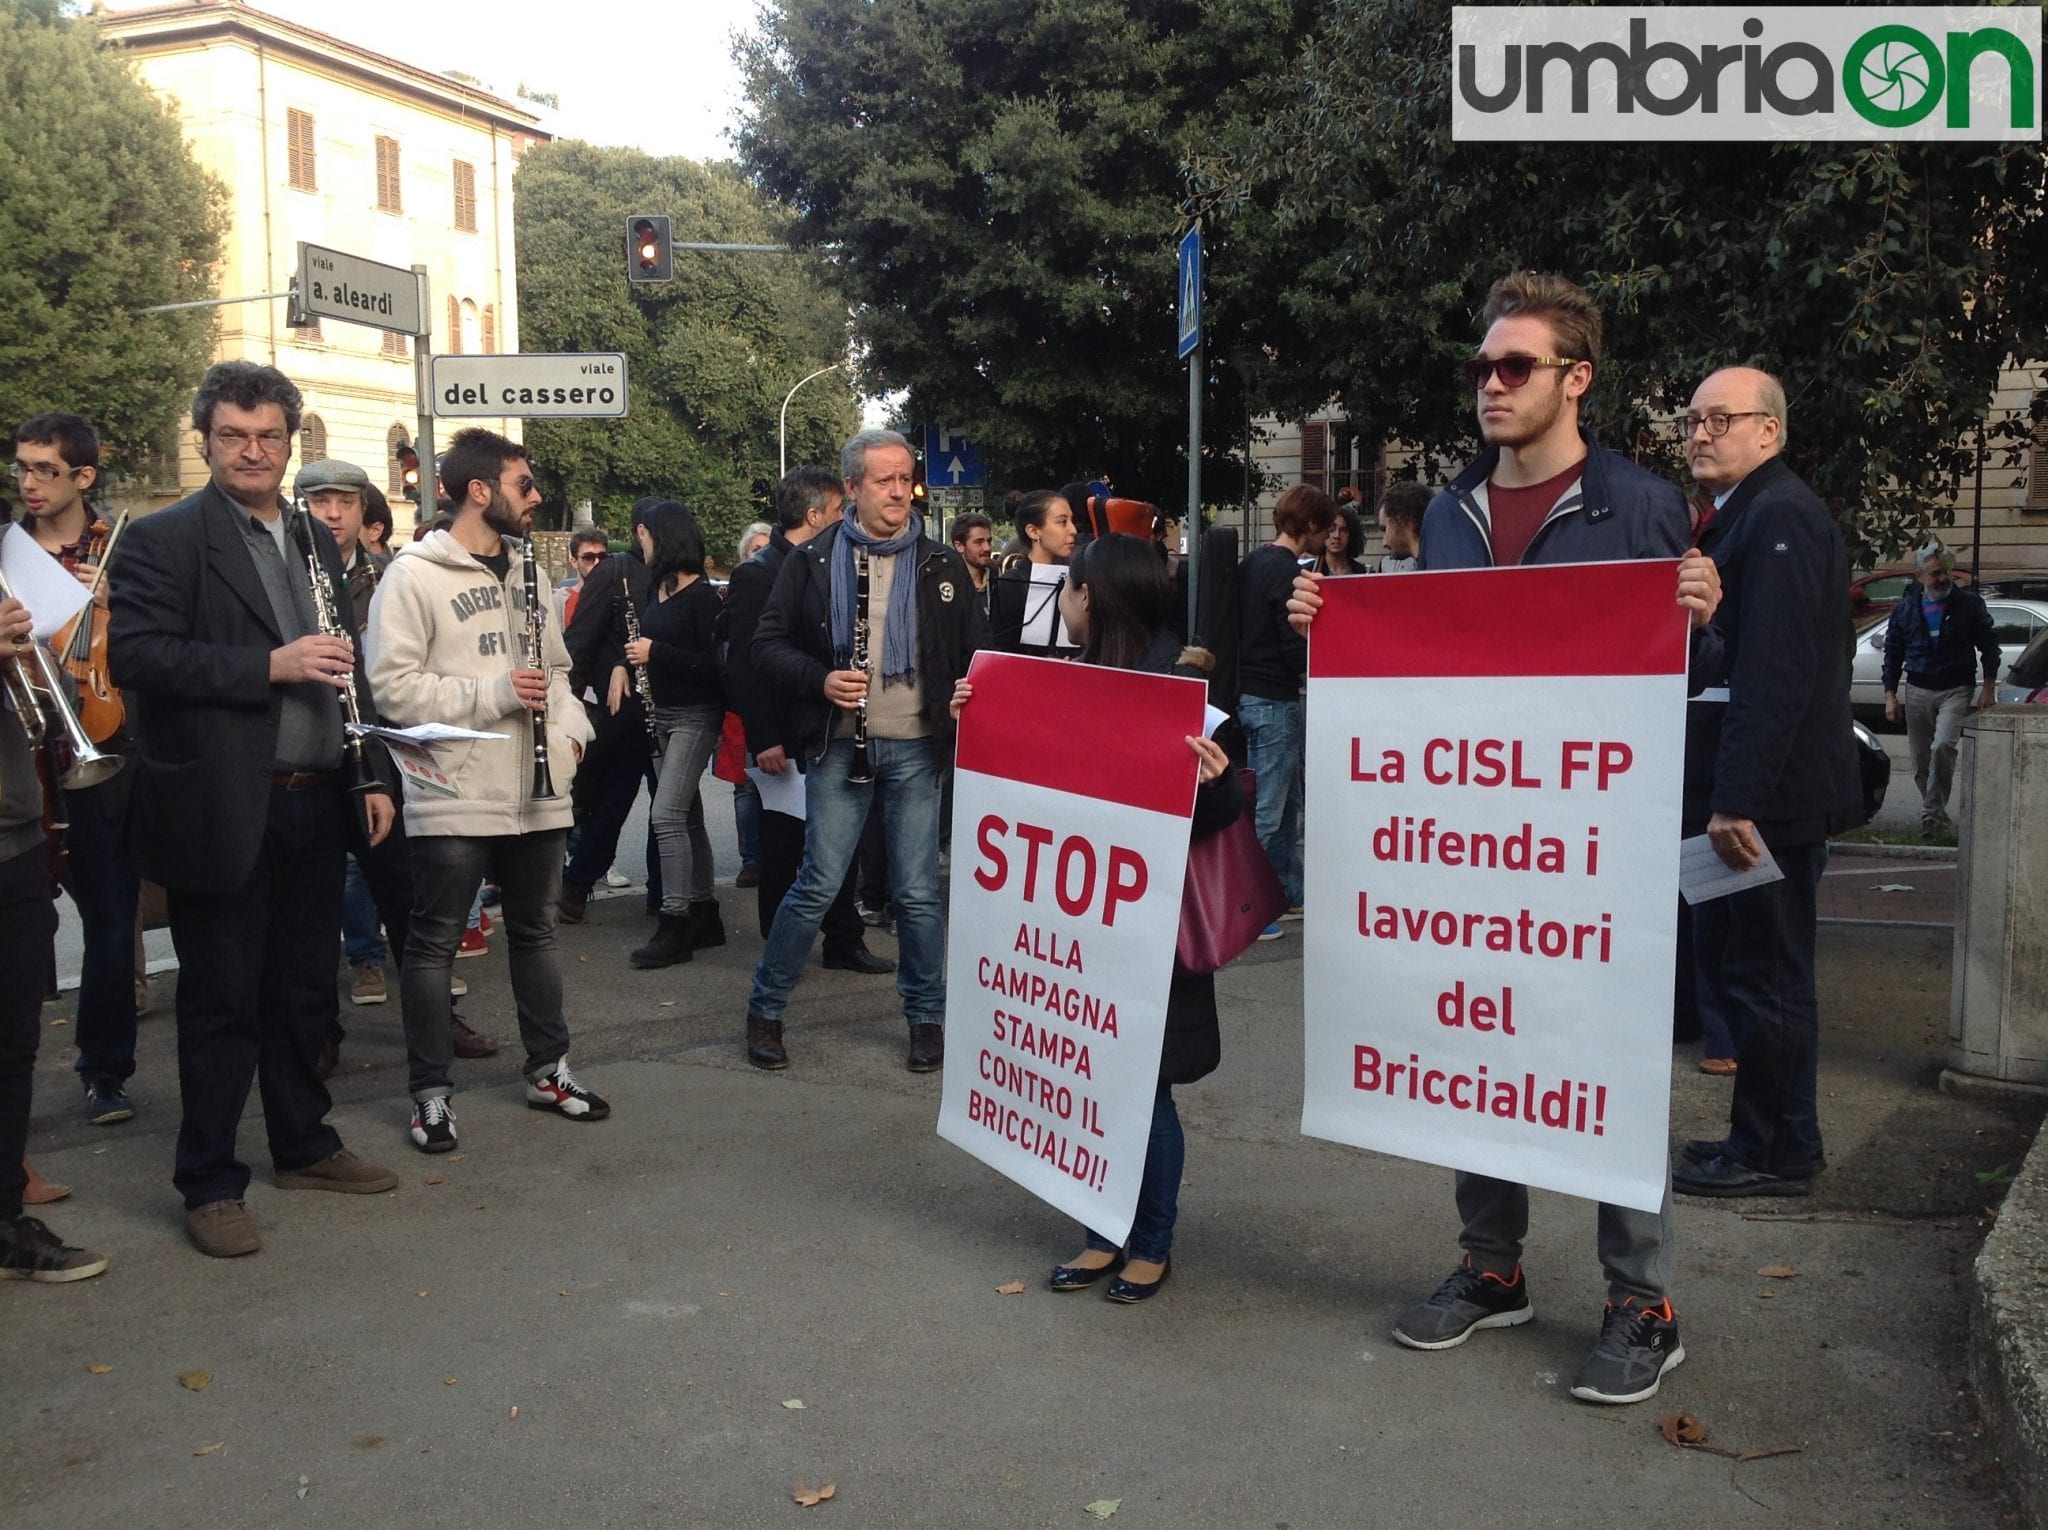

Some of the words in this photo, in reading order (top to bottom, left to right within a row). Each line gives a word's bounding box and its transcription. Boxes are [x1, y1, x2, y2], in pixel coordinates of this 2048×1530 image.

[312, 255, 334, 272] viale
[313, 281, 328, 301] a.
[333, 283, 393, 316] aleardi
[444, 383, 488, 404] del
[502, 387, 614, 404] cassero
[580, 362, 614, 374] viale
[1350, 736, 1405, 783] La
[1423, 737, 1542, 789] CISL
[1560, 740, 1633, 791] FP
[974, 814, 1149, 927] STOP
[1372, 816, 1566, 874] difenda
[1587, 826, 1599, 876] i
[1014, 923, 1084, 974] ALLA
[1358, 891, 1612, 963] lavoratori
[978, 957, 1119, 1039] CAMPAGNA
[1437, 980, 1516, 1036] del
[993, 1009, 1092, 1080] STAMPA
[979, 1049, 1072, 1120] CONTRO
[1082, 1097, 1105, 1138] IL
[1353, 1045, 1607, 1136] Briccialdi!
[968, 1089, 1108, 1193] BRICCIALDI!
